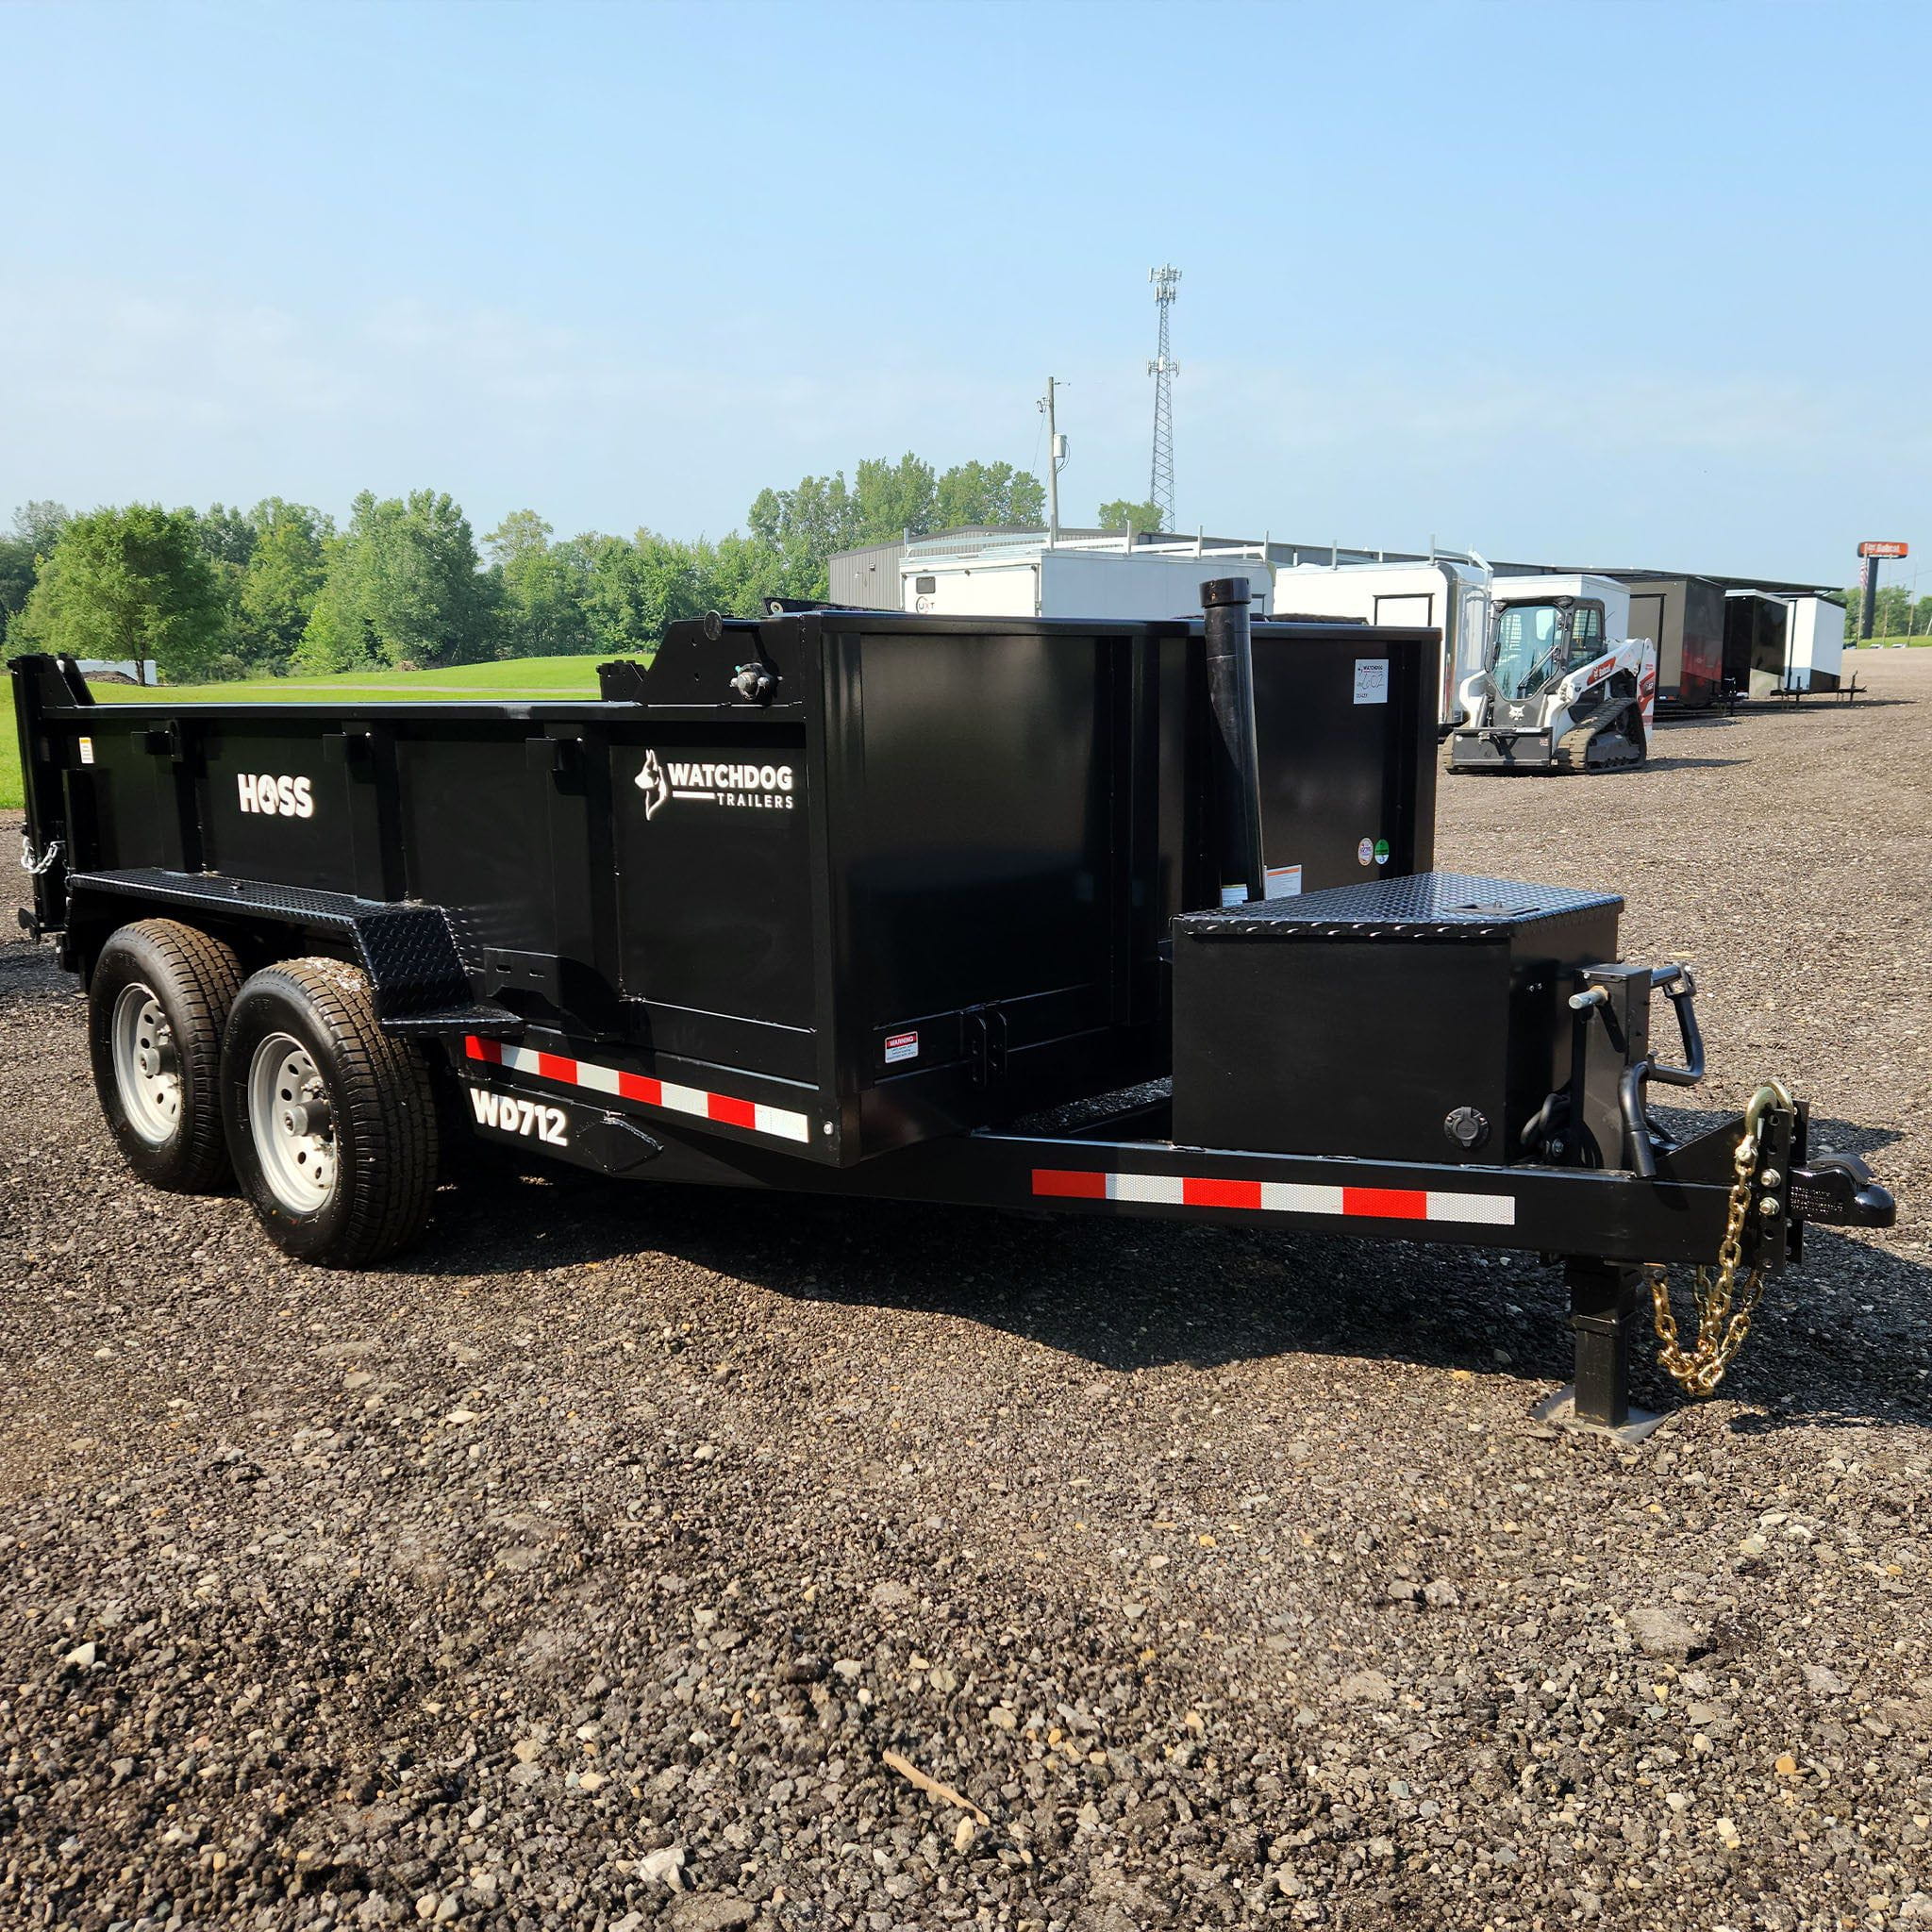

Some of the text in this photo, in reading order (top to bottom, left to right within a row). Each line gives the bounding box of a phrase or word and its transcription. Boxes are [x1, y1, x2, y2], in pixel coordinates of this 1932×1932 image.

[667, 763, 792, 791] WATCHDOG
[238, 774, 314, 819] HOSS
[717, 792, 793, 809] TRAILERS
[890, 1036, 914, 1047] WARNING
[470, 1088, 568, 1147] WD712
